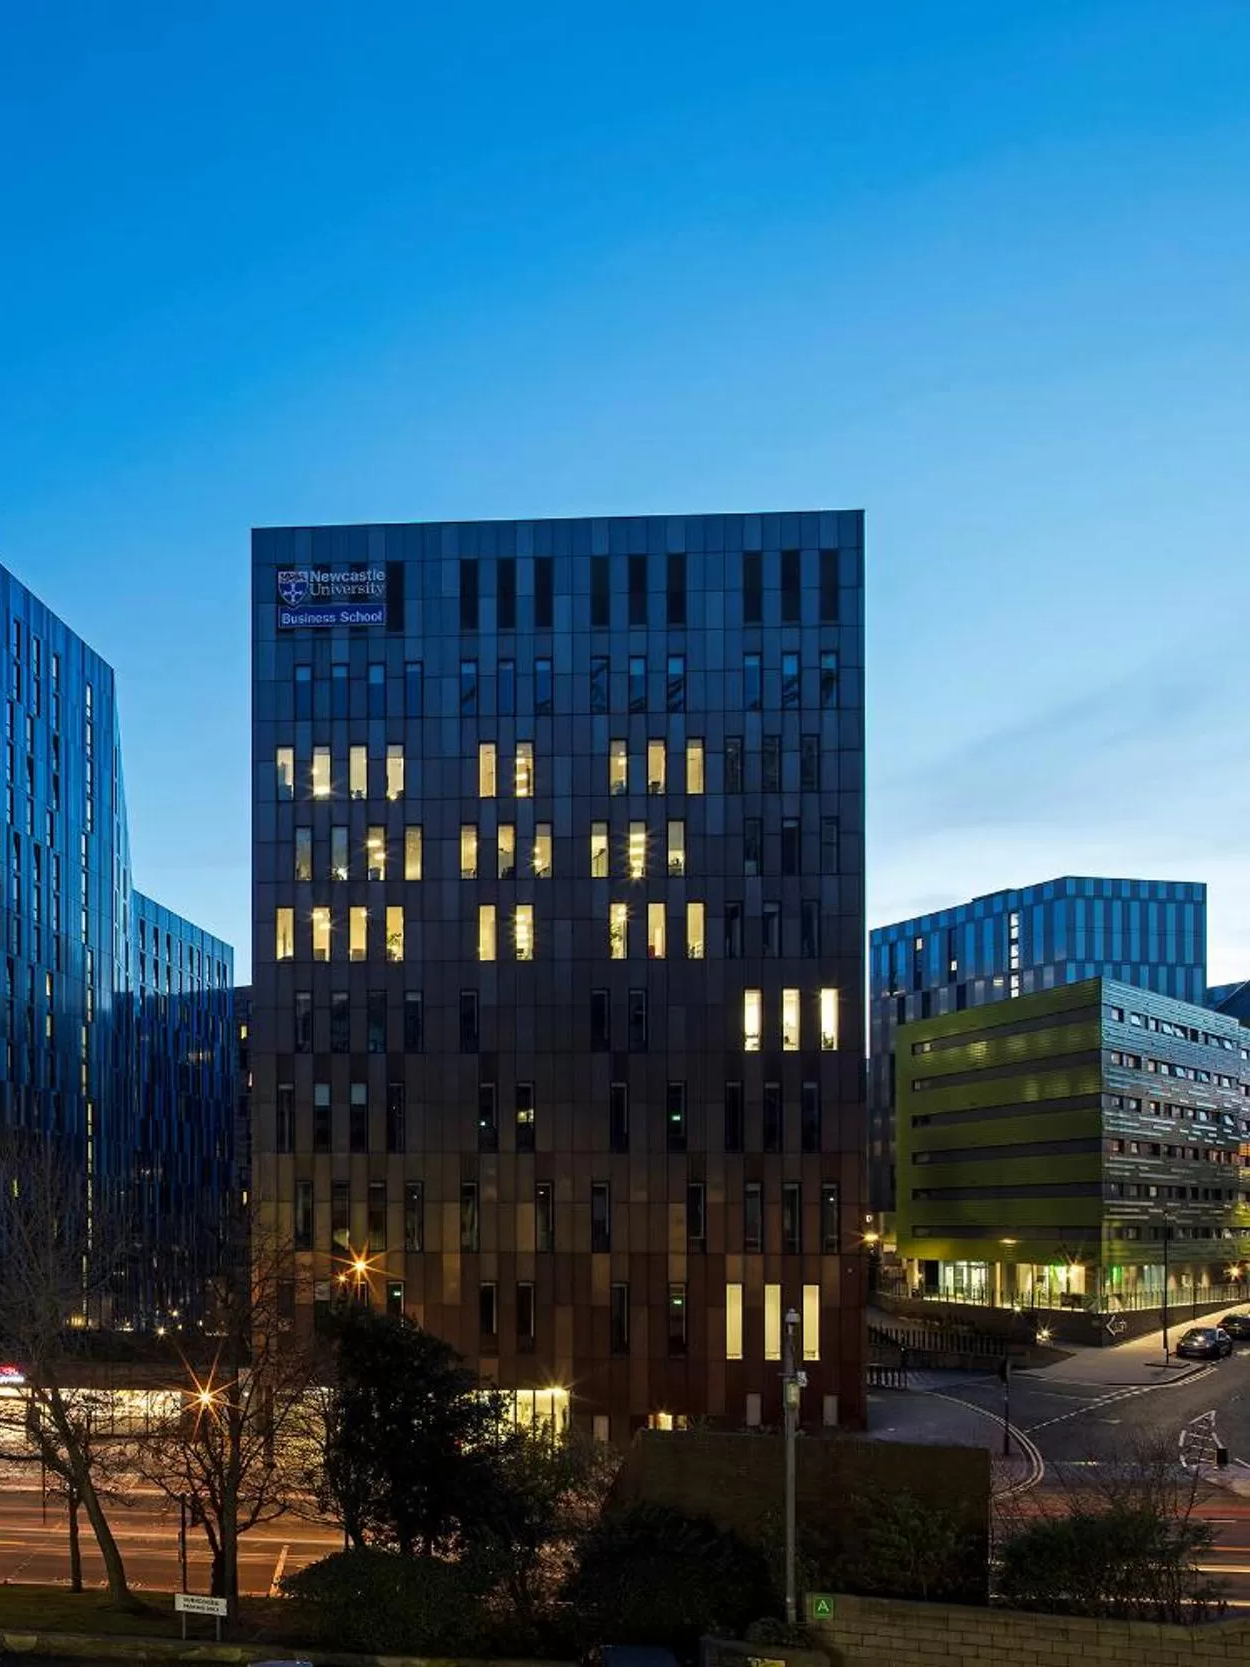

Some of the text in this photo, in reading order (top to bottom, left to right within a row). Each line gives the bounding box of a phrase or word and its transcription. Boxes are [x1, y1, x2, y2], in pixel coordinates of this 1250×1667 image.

[309, 569, 386, 582] Newcastle
[310, 581, 385, 597] University
[281, 610, 383, 625] Business School
